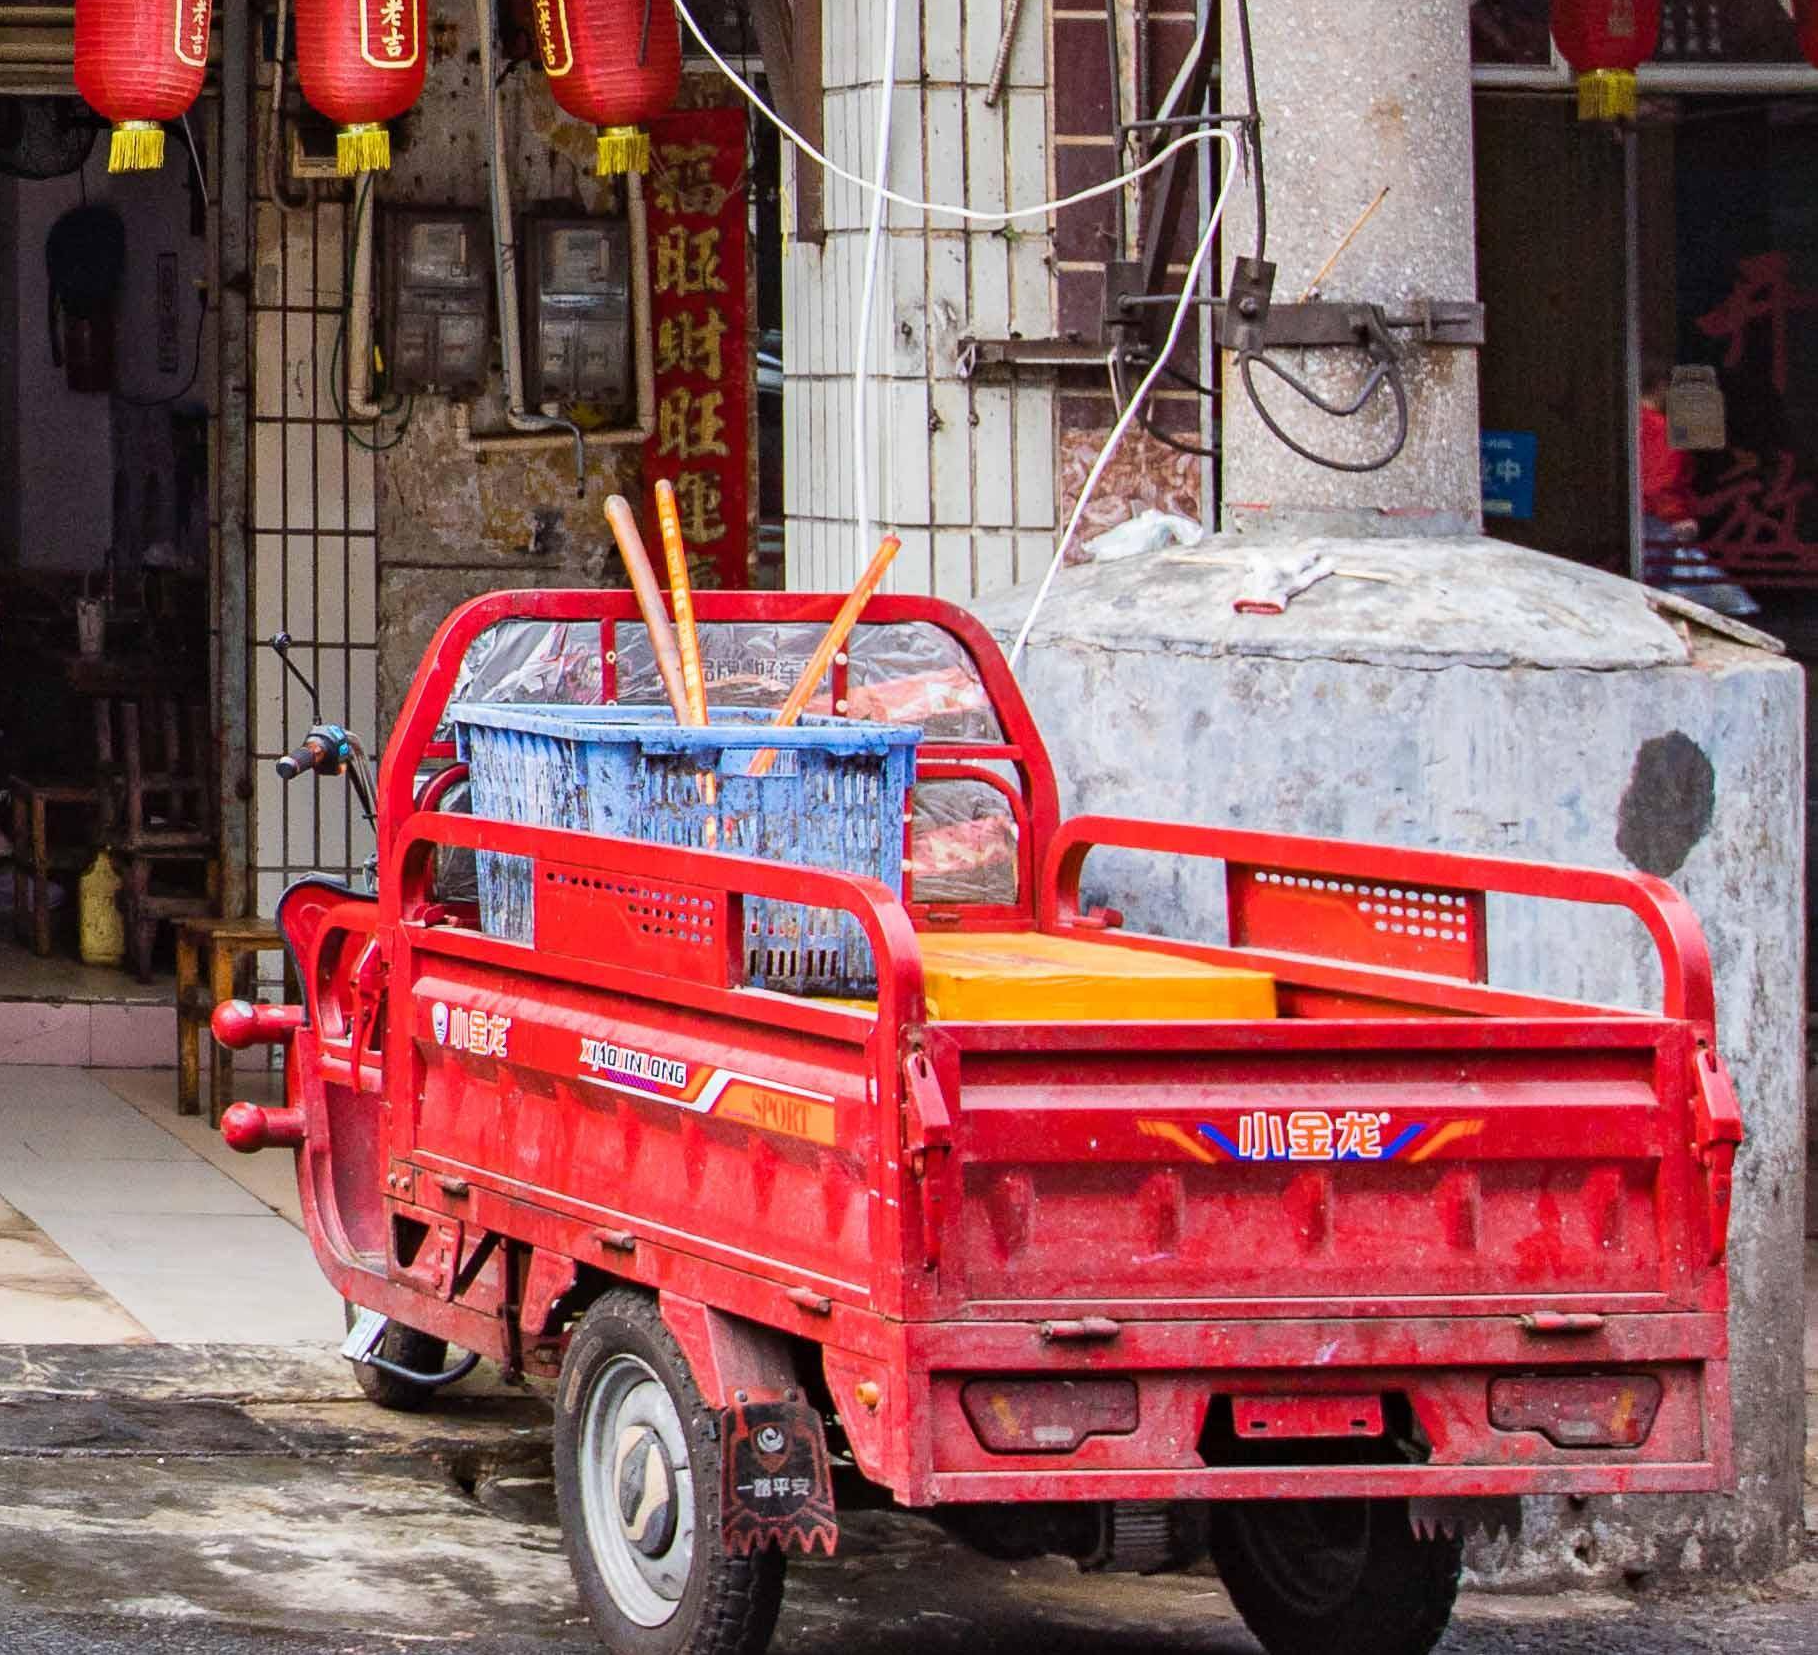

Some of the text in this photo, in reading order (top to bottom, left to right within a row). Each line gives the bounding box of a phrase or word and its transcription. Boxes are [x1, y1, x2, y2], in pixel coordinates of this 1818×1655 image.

[449, 1007, 512, 1058] 小金龙
[751, 1094, 812, 1136] SPORT
[1238, 1111, 1384, 1161] 小金龙
[736, 1476, 810, 1498] 一路平安
